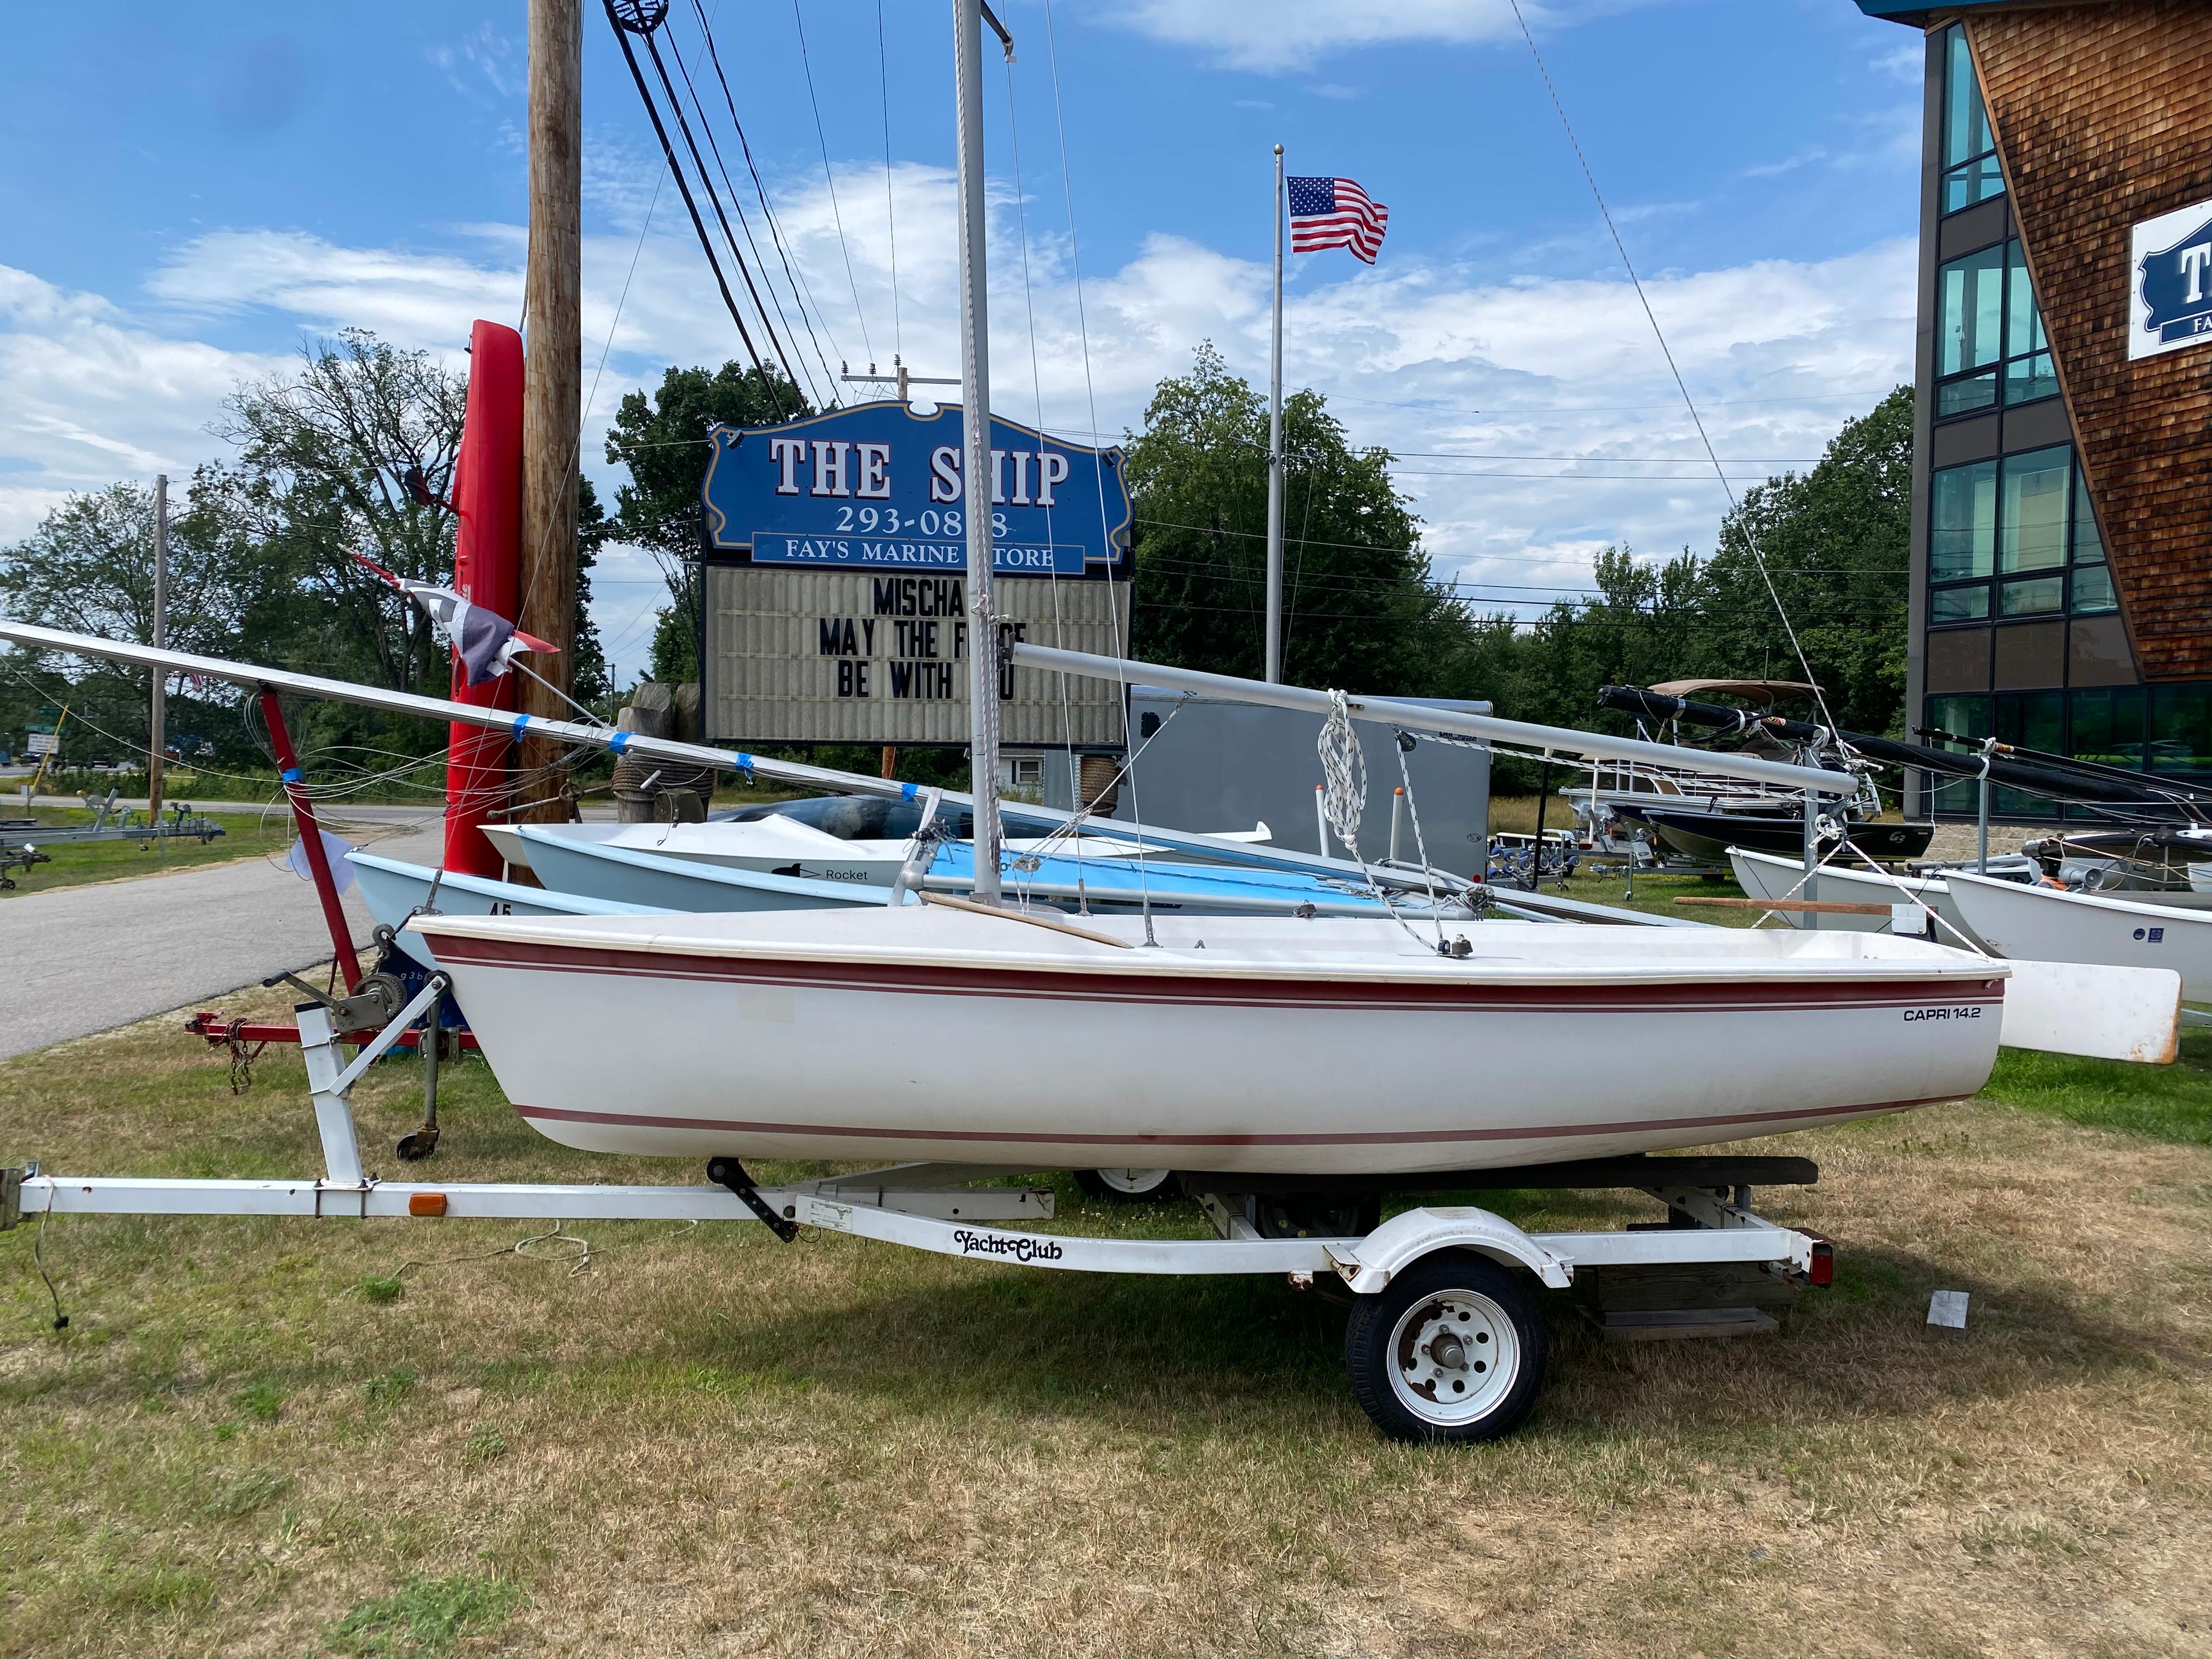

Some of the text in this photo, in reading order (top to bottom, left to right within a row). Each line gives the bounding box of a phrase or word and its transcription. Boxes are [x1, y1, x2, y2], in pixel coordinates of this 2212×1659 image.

[770, 438, 891, 498] THE
[836, 506, 1008, 538] 293-088
[786, 539, 1054, 567] FAY'S MARINE TORE
[874, 578, 964, 617] MISCHA
[820, 618, 875, 656] MAY
[894, 620, 938, 658] THE
[838, 660, 951, 699] BE WITH
[826, 870, 868, 880] Rocket
[1904, 1007, 1981, 1021] CAPRI 14.2
